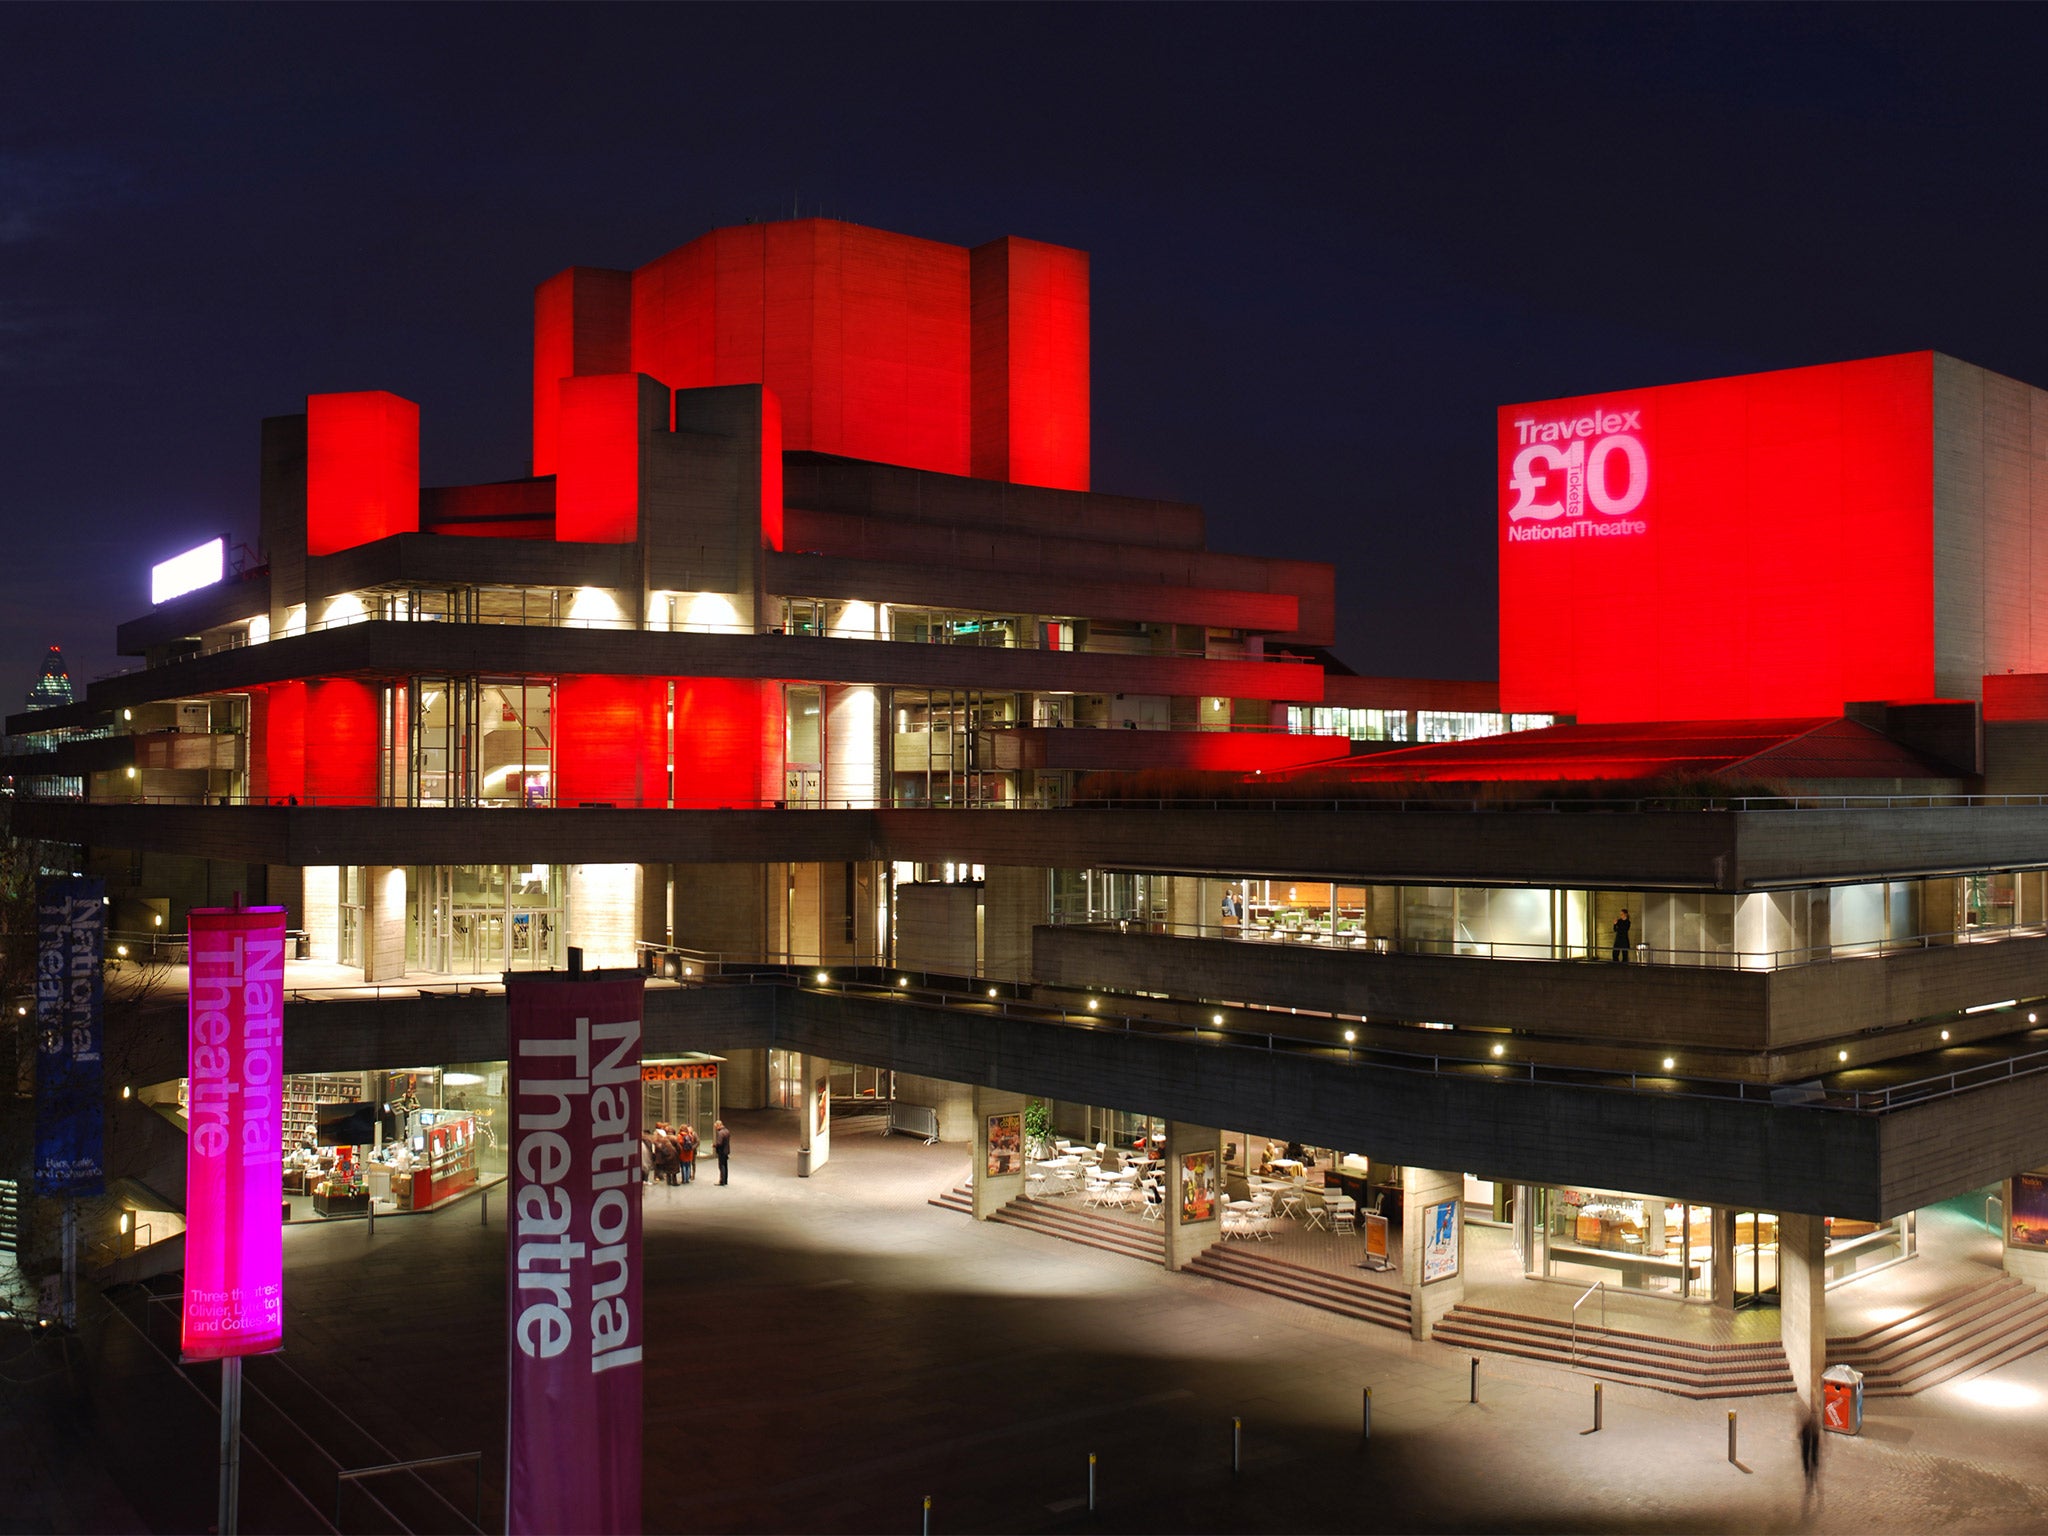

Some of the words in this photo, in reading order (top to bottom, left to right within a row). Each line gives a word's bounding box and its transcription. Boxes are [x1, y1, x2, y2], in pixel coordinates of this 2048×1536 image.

[1514, 409, 1642, 445] Travelex
[1508, 434, 1648, 522] £10
[1569, 462, 1583, 515] Tickets
[71, 898, 102, 1062] National
[193, 937, 243, 1158] Theatre
[243, 940, 284, 1166] National
[642, 1064, 718, 1081] elcome
[516, 1017, 590, 1359] Theatre
[590, 1020, 643, 1374] National
[189, 1303, 231, 1318] Olivier,
[191, 1289, 229, 1302] Three
[193, 1319, 218, 1331] and
